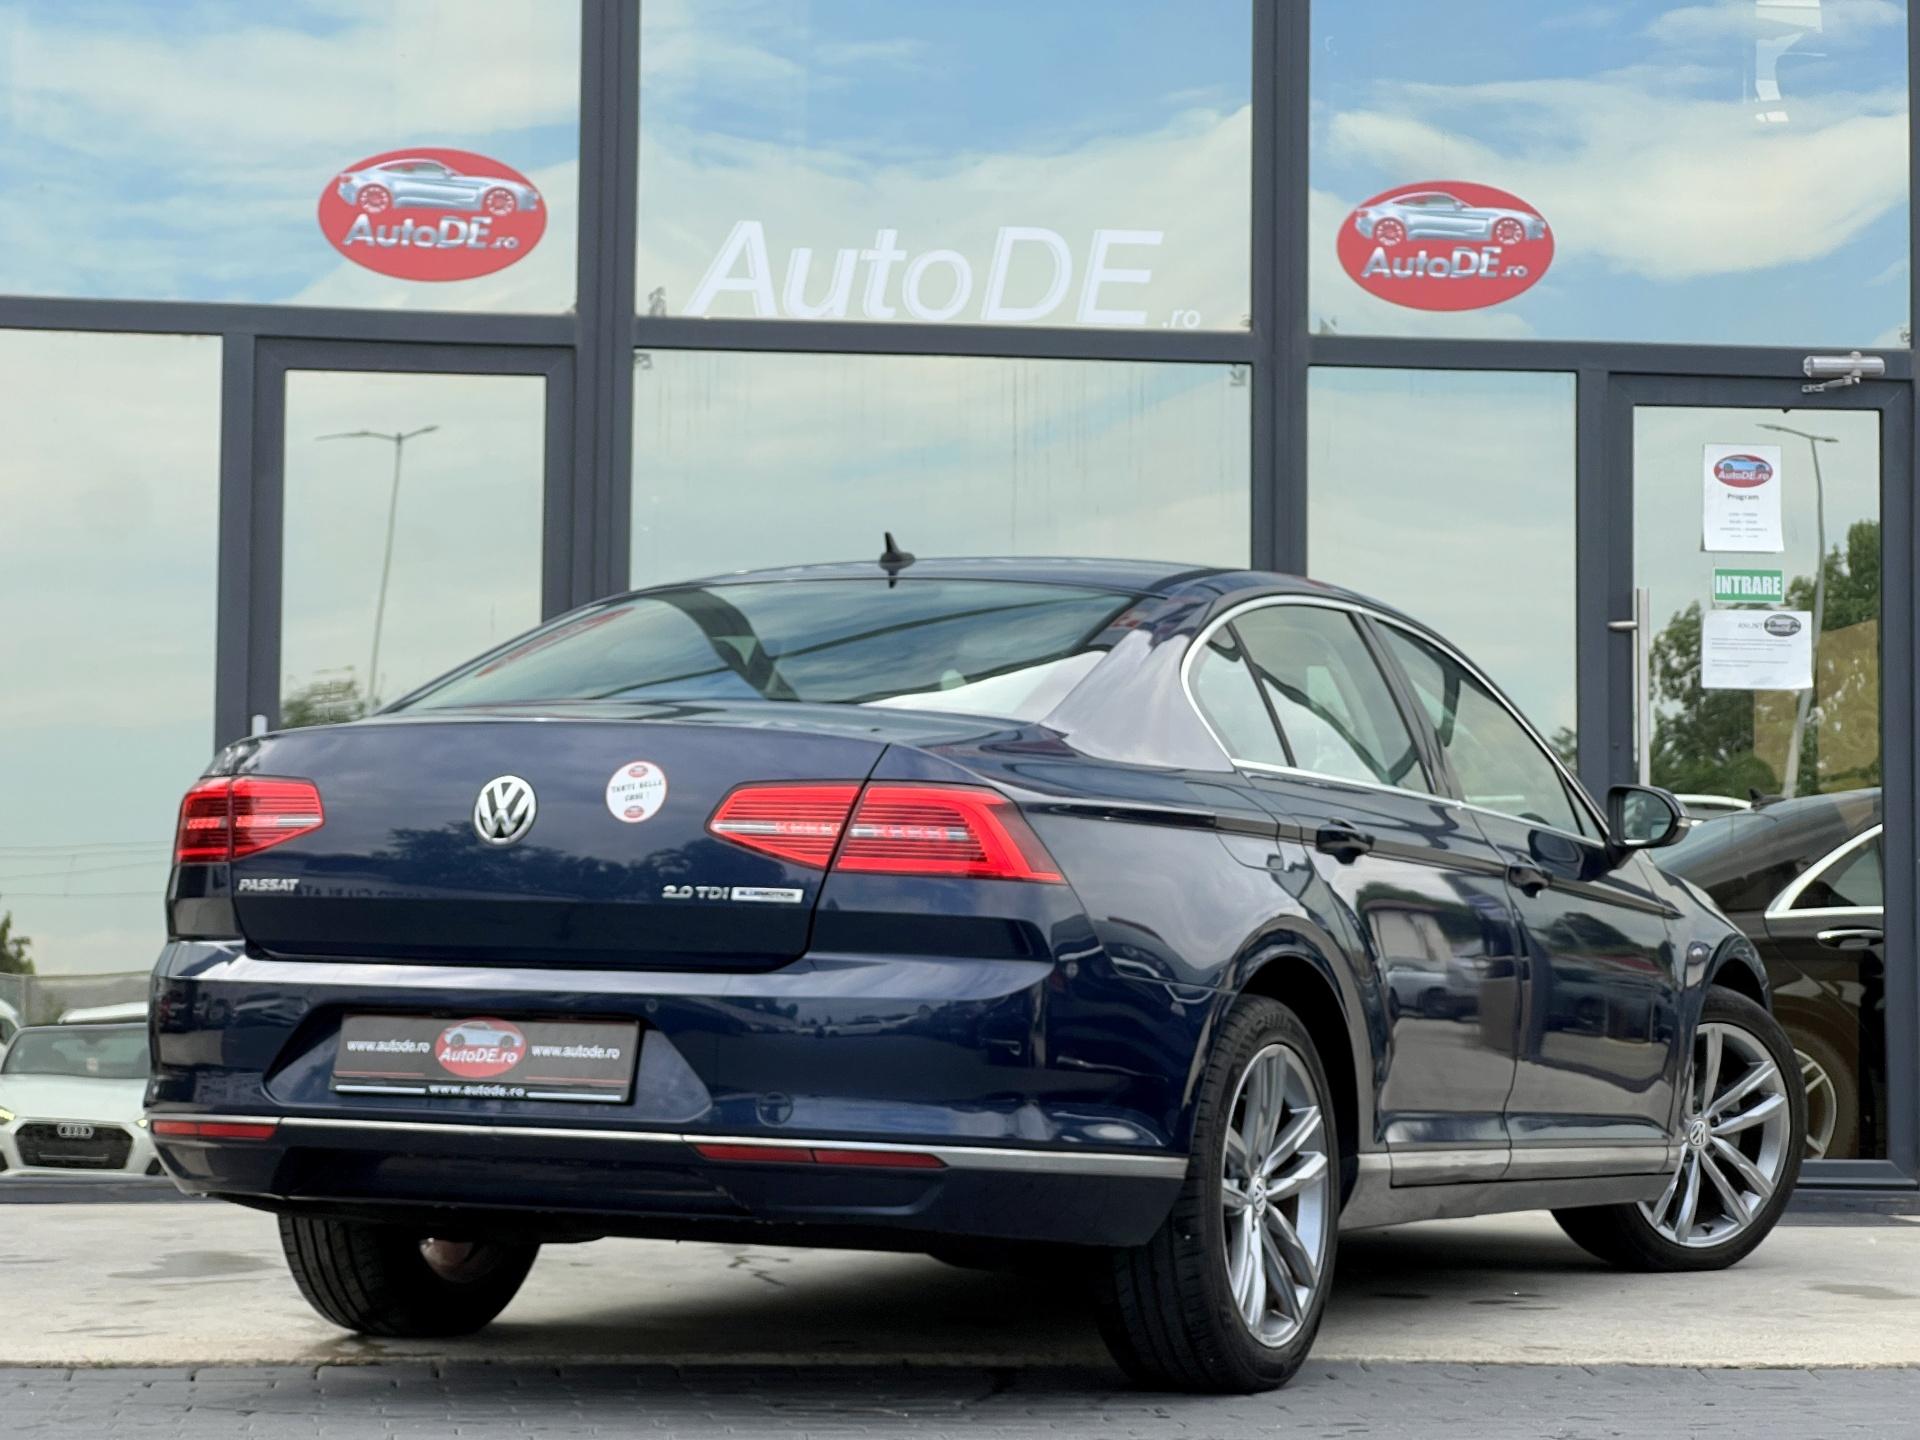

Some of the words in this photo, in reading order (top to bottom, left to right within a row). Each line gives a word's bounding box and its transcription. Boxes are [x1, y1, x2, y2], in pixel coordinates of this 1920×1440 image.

[1715, 575, 1782, 595] INTRARE
[238, 878, 300, 892] PASSAT
[695, 886, 731, 900] TDI
[346, 1039, 431, 1053] www.autode.ro
[531, 1043, 621, 1060] www.autode.ro
[438, 1047, 519, 1064] AutoDE.ro
[428, 1083, 526, 1098] www.autode.ro
